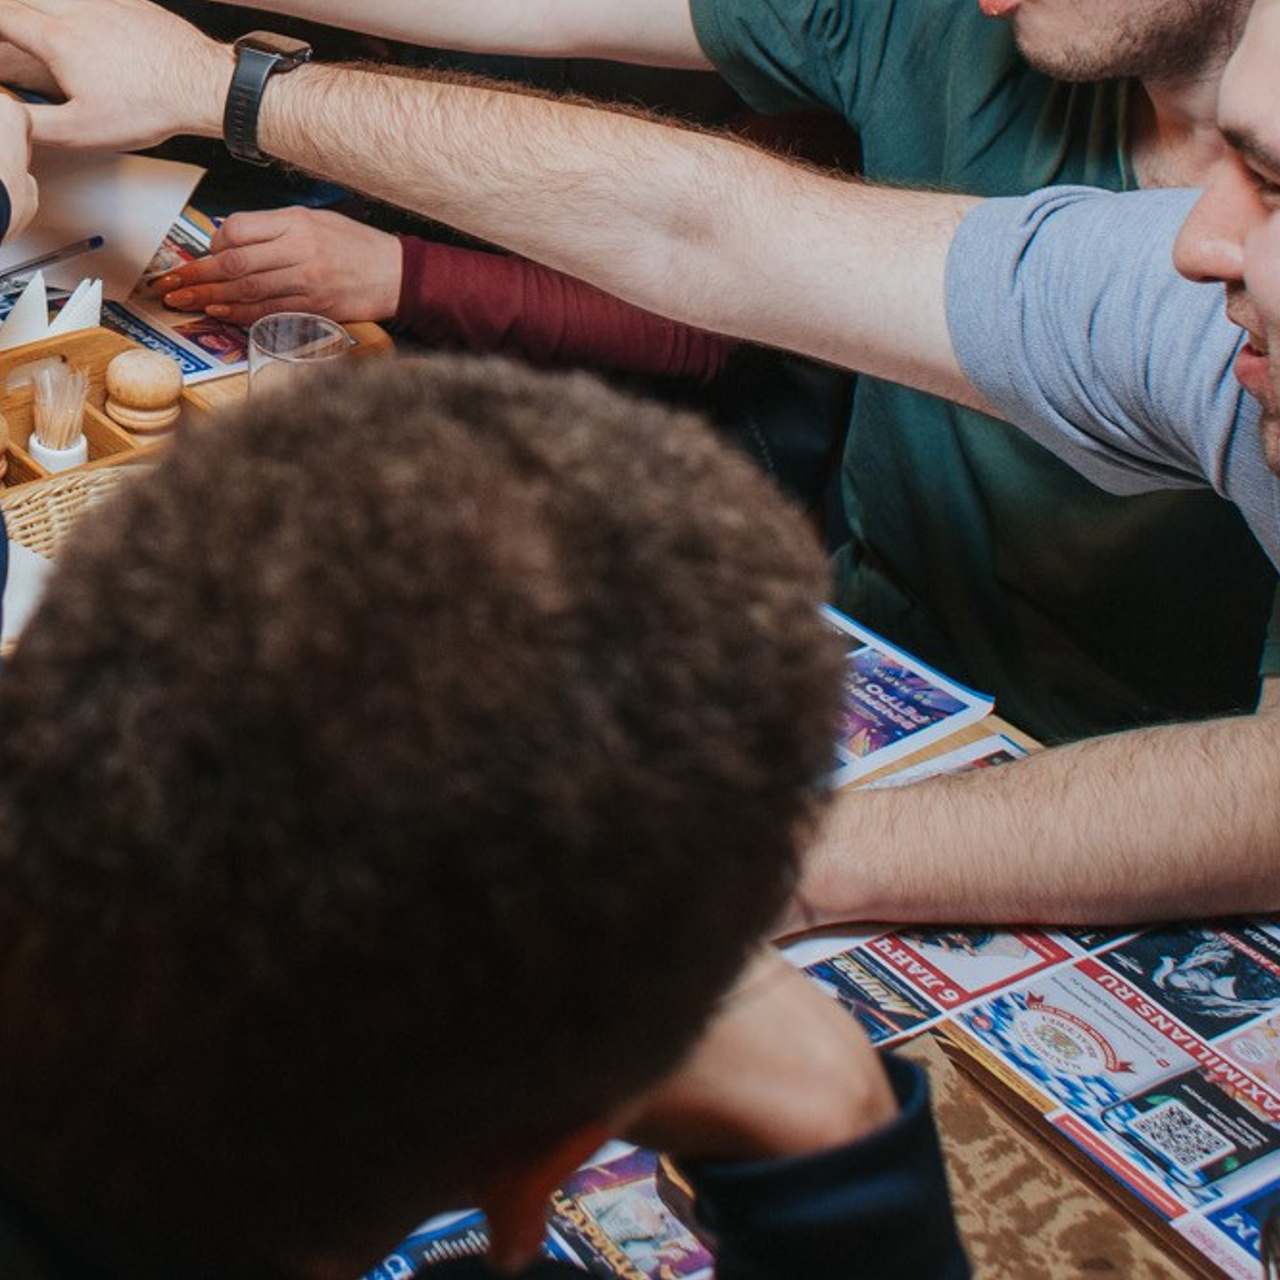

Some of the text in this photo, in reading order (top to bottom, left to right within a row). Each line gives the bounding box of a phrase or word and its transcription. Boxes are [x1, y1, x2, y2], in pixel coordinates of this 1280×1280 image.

[865, 683, 930, 724] РЕТРО
[872, 936, 947, 988] ЛАНЧ
[938, 987, 961, 1003] 6
[1095, 972, 1280, 1122] AXIMILIANS.RU
